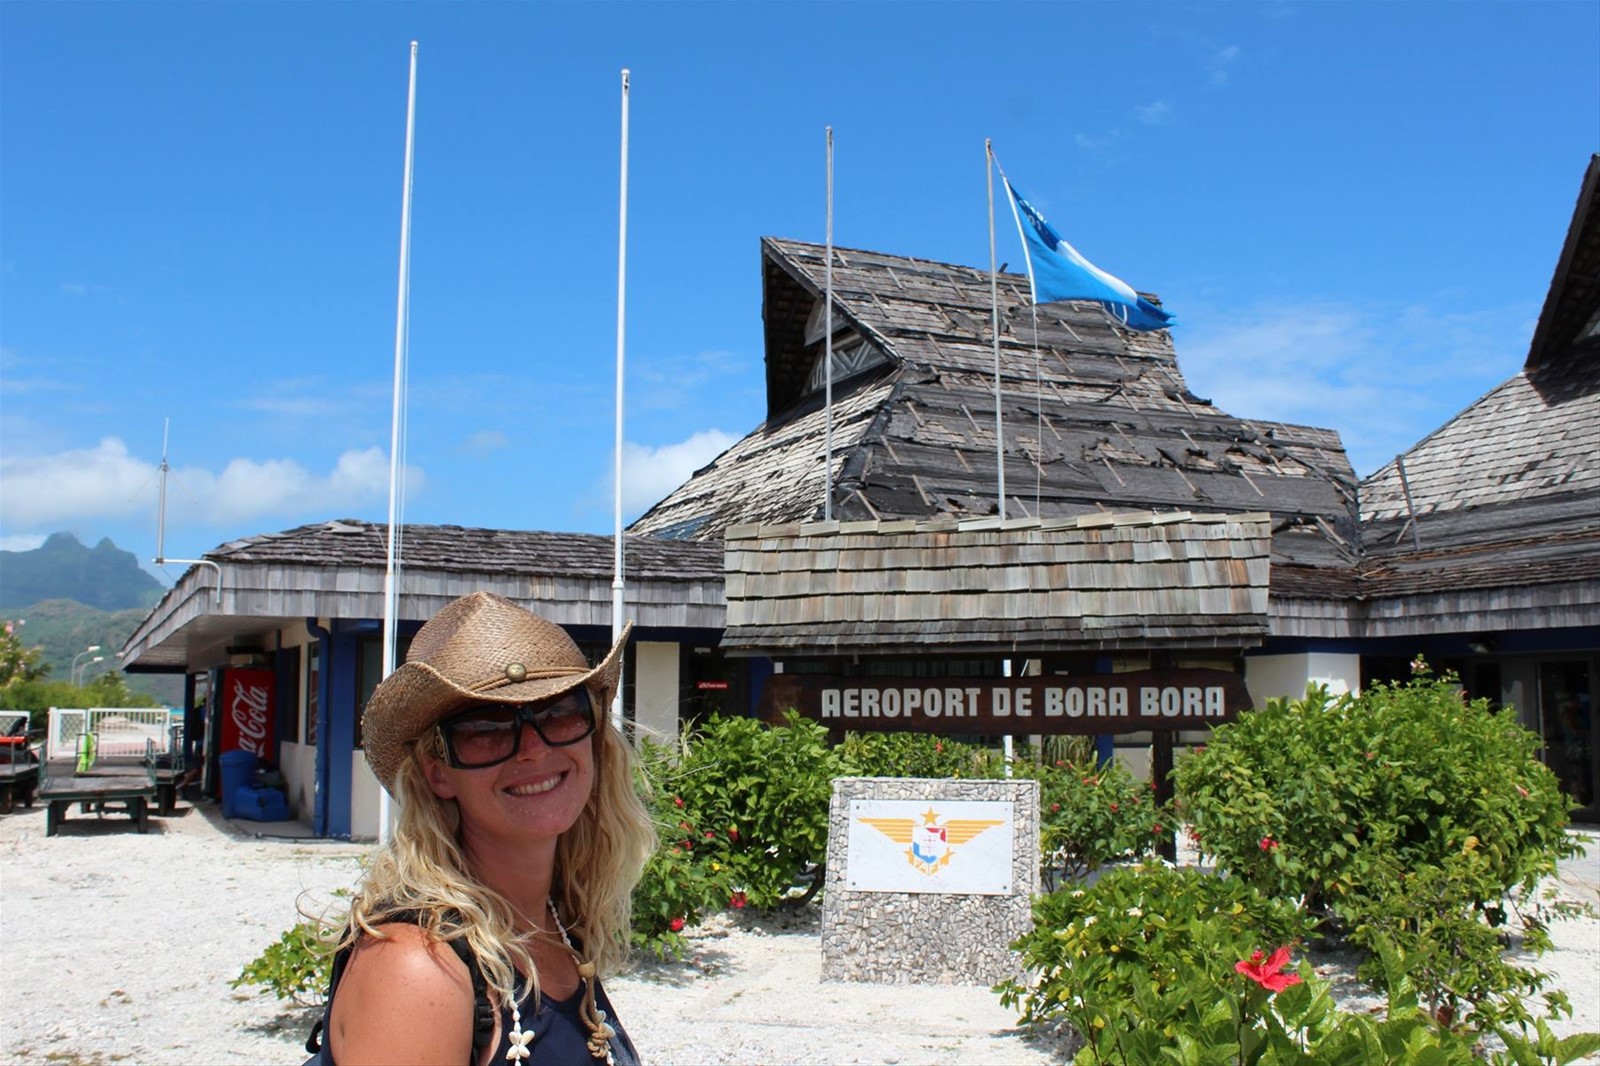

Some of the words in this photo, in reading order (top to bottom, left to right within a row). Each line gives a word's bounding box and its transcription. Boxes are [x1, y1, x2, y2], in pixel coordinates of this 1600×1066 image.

[822, 688, 980, 717] AEROPORT
[993, 688, 1031, 716] DE
[1045, 688, 1128, 717] BORA
[1141, 687, 1224, 716] BORA
